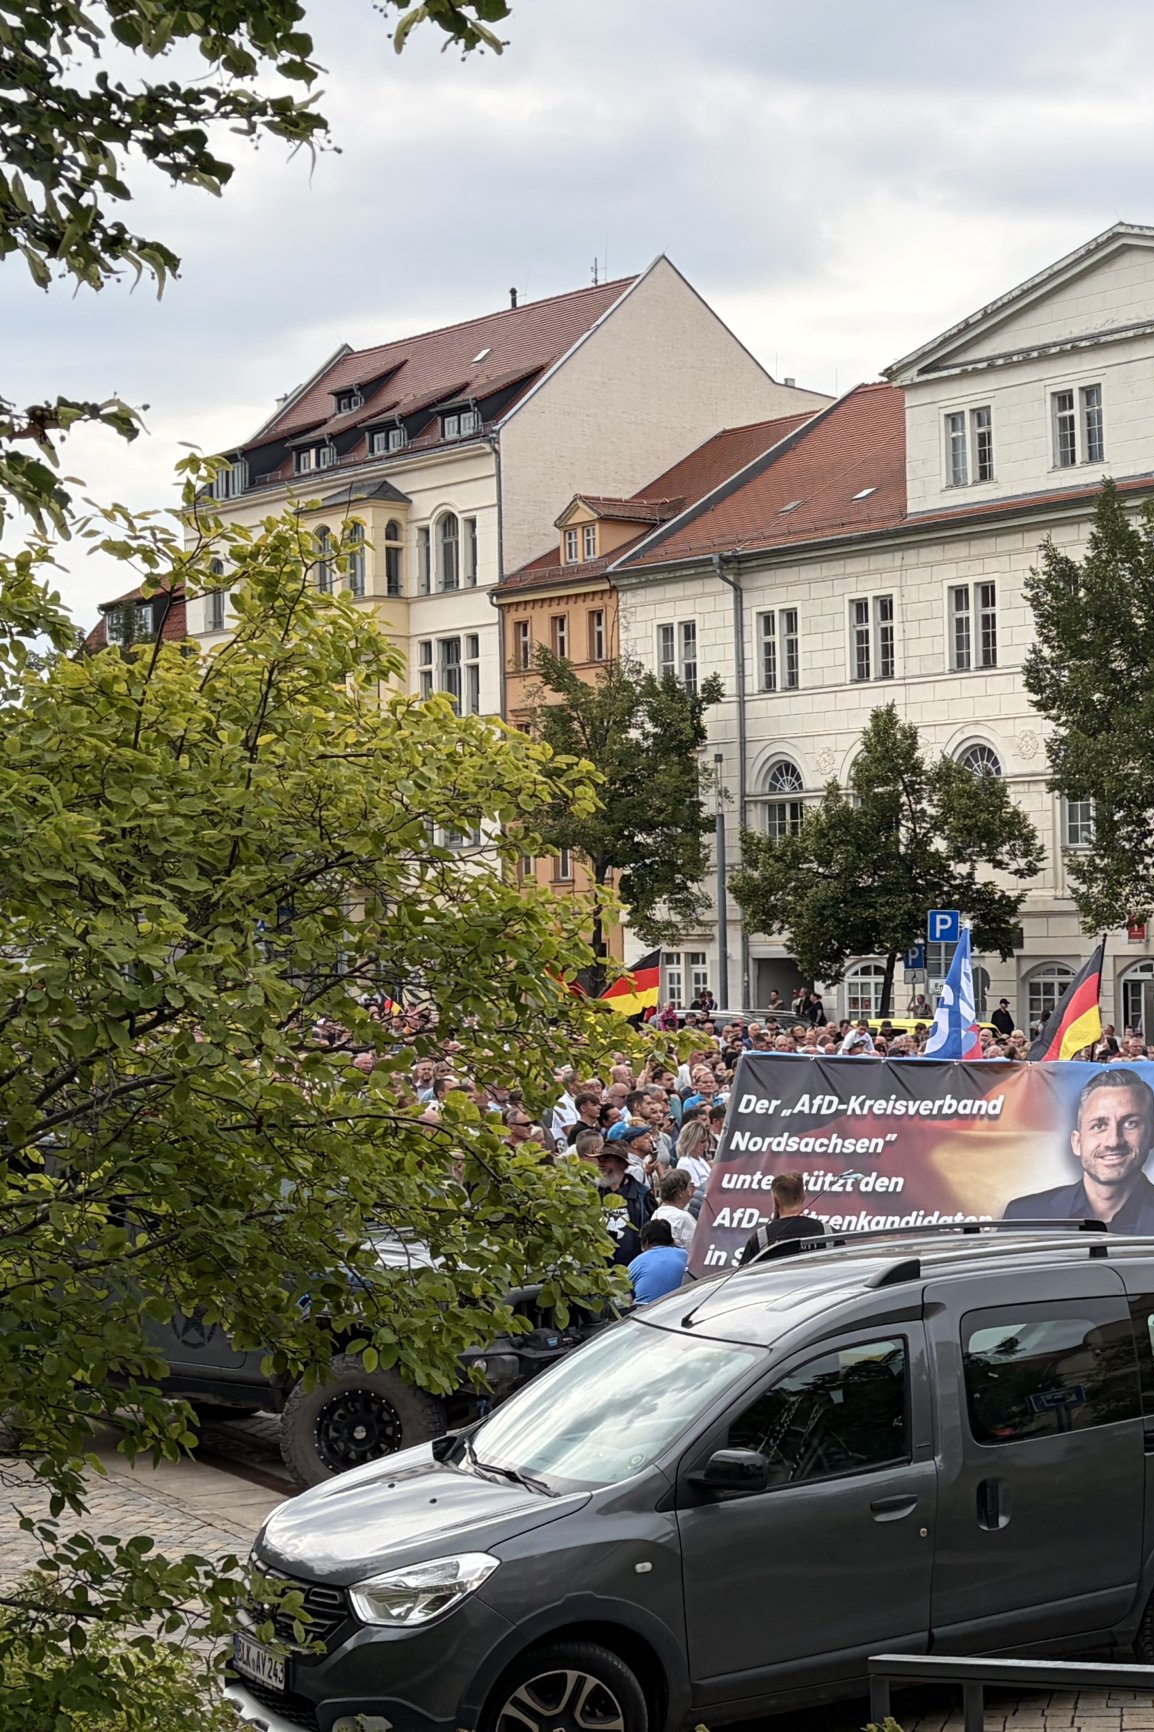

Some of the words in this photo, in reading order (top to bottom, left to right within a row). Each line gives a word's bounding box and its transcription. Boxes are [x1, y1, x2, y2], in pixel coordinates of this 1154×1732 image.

[936, 915, 952, 938] P
[908, 947, 919, 966] P
[738, 1094, 781, 1114] Der
[721, 1170, 855, 1192] untetützt
[859, 1172, 904, 1192] den
[704, 1244, 727, 1266] in
